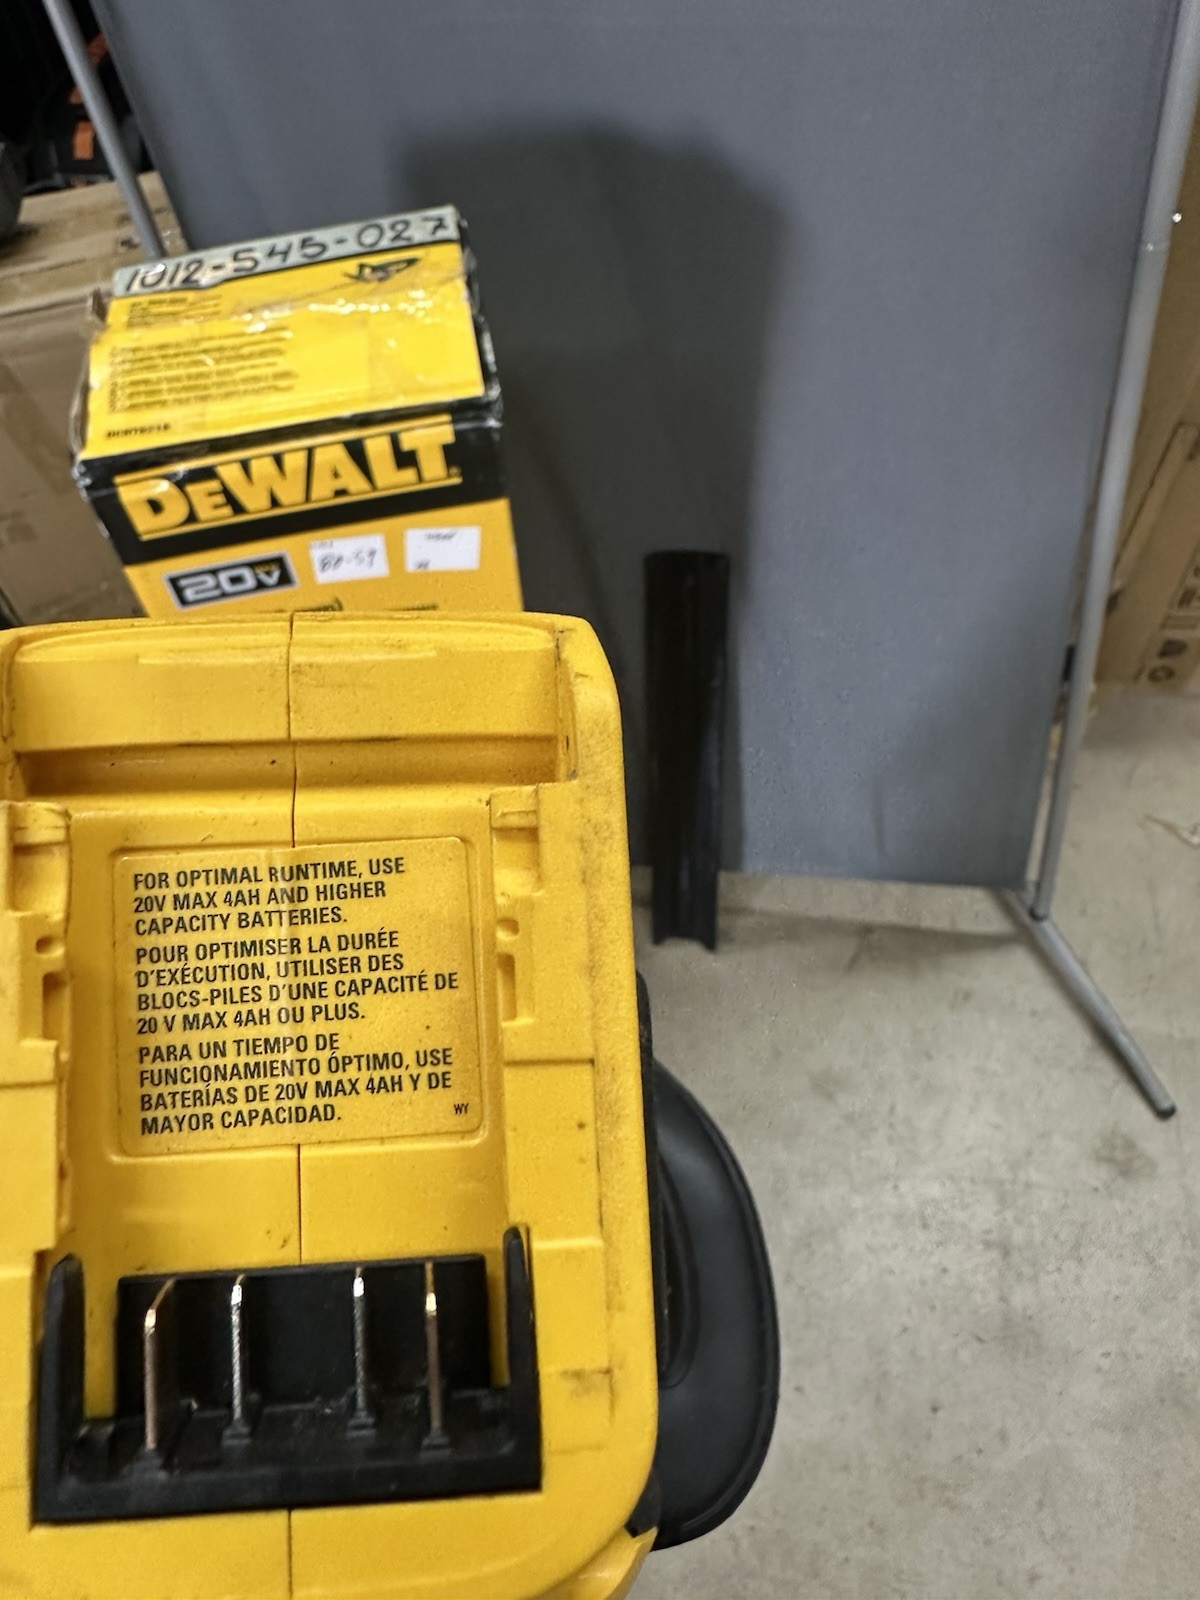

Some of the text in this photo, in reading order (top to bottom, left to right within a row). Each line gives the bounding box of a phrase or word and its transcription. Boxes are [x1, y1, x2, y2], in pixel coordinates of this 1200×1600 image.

[125, 217, 450, 290] 1012-545-027
[134, 858, 405, 890] FOR OPTIMAL RUNTIME, USE
[134, 881, 386, 913] 20V MAX 4AH AND HIGHER
[135, 906, 348, 936] CAPACITY BATTERIES.
[136, 927, 399, 964] POUR OPTIMISER LA DURÉE
[135, 953, 404, 988] D'EXÉCUTION, UTILISER DES
[138, 970, 459, 1011] BLOCS-PILES D'UNE CAPACITÉ DE
[137, 1002, 365, 1034] 20 V MAX 4AH OU PLUS.
[138, 1033, 340, 1064] PARA UN TIEMPO DE
[139, 1048, 453, 1088] FUNCIONAMIENTO ÓPTIMO, USE
[141, 1071, 452, 1112] BATERÍAS DE 20V MAX 4AH Y DE
[141, 1103, 342, 1136] MAYOR CAPACIDAD.
[454, 1102, 469, 1115] WY
